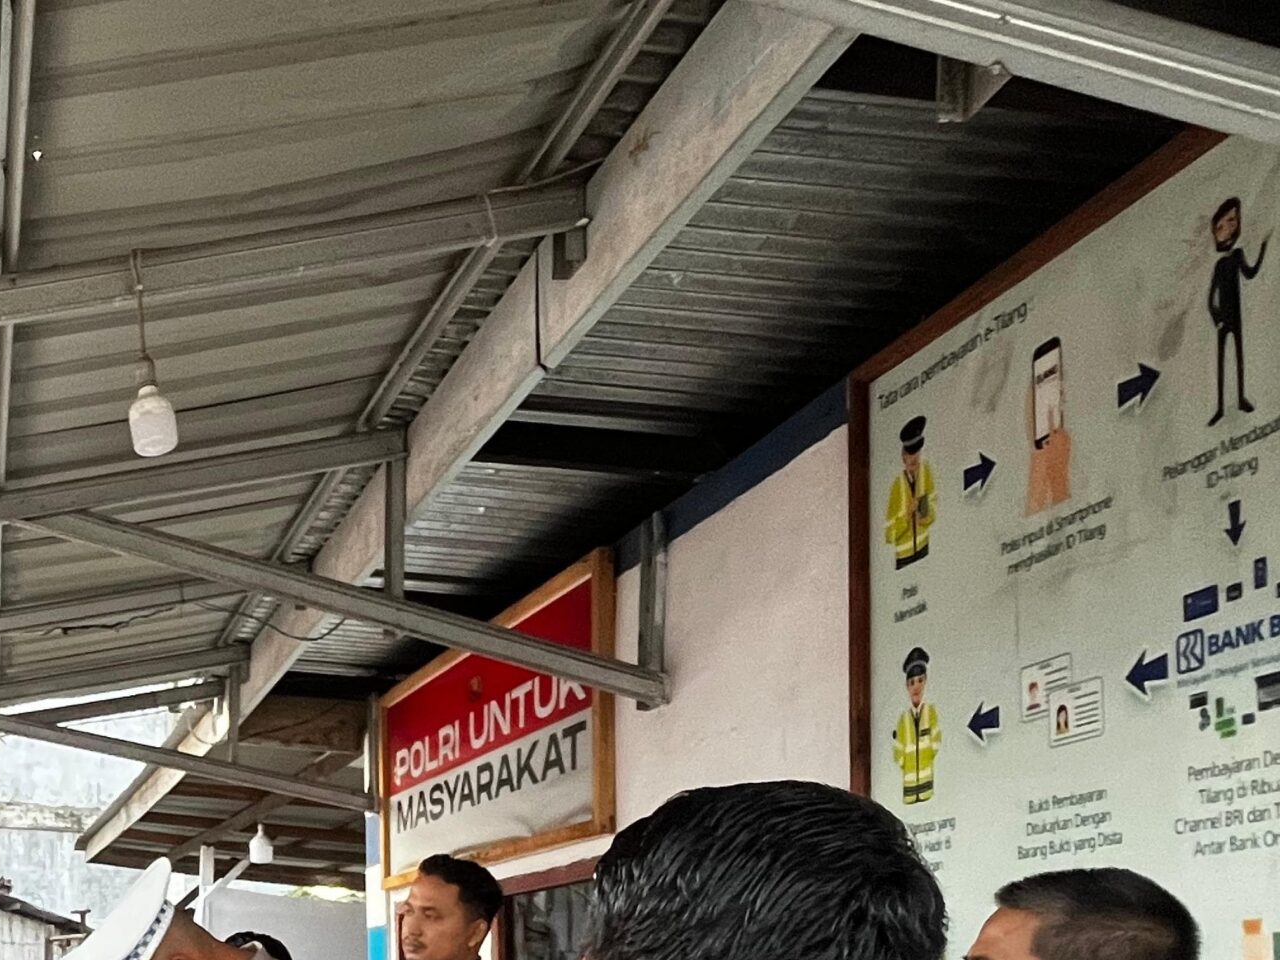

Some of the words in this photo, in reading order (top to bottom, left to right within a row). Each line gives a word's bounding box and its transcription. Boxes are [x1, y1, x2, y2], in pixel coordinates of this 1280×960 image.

[1208, 618, 1265, 657] BANK
[393, 720, 461, 787] POLRI
[469, 674, 587, 750] UNTUK
[396, 720, 587, 834] MASYARAKAT
[1187, 756, 1261, 782] Pembayaran
[1198, 786, 1234, 806] Tilang
[1074, 811, 1112, 830] Dengan
[1175, 813, 1222, 835] Channel
[1224, 809, 1244, 828] BRI
[1247, 806, 1272, 824] dan
[1194, 841, 1226, 858] Antar
[1229, 834, 1262, 853] Bank
